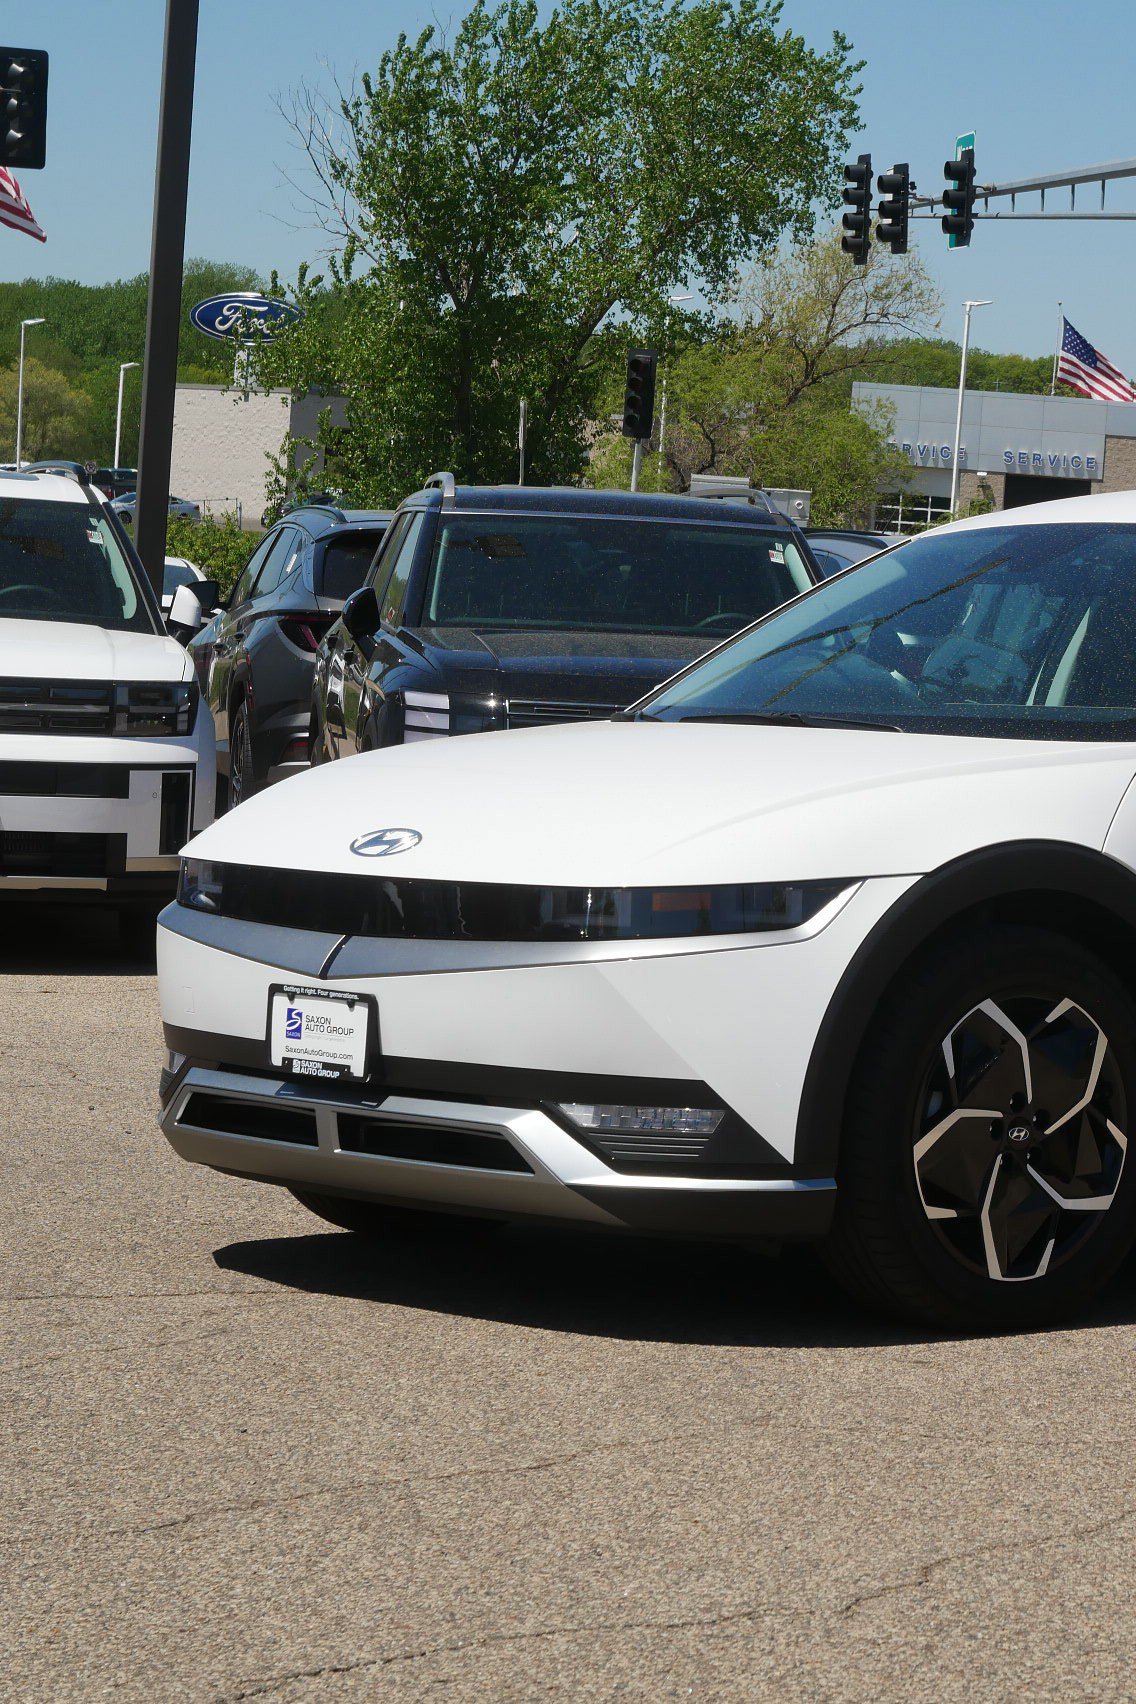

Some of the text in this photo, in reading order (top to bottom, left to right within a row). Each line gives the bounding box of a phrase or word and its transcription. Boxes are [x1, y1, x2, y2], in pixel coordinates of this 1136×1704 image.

[887, 441, 1096, 470] RVICE SERVICE
[283, 985, 300, 994] Getting
[328, 991, 360, 1000] generations.
[305, 1014, 331, 1025] SAXON
[305, 1023, 355, 1036] AUTO GROUP
[285, 1045, 354, 1060] SaxonAutoGroup.com
[300, 1060, 323, 1070] SAXON
[300, 1067, 340, 1079] AUTO GROUP
